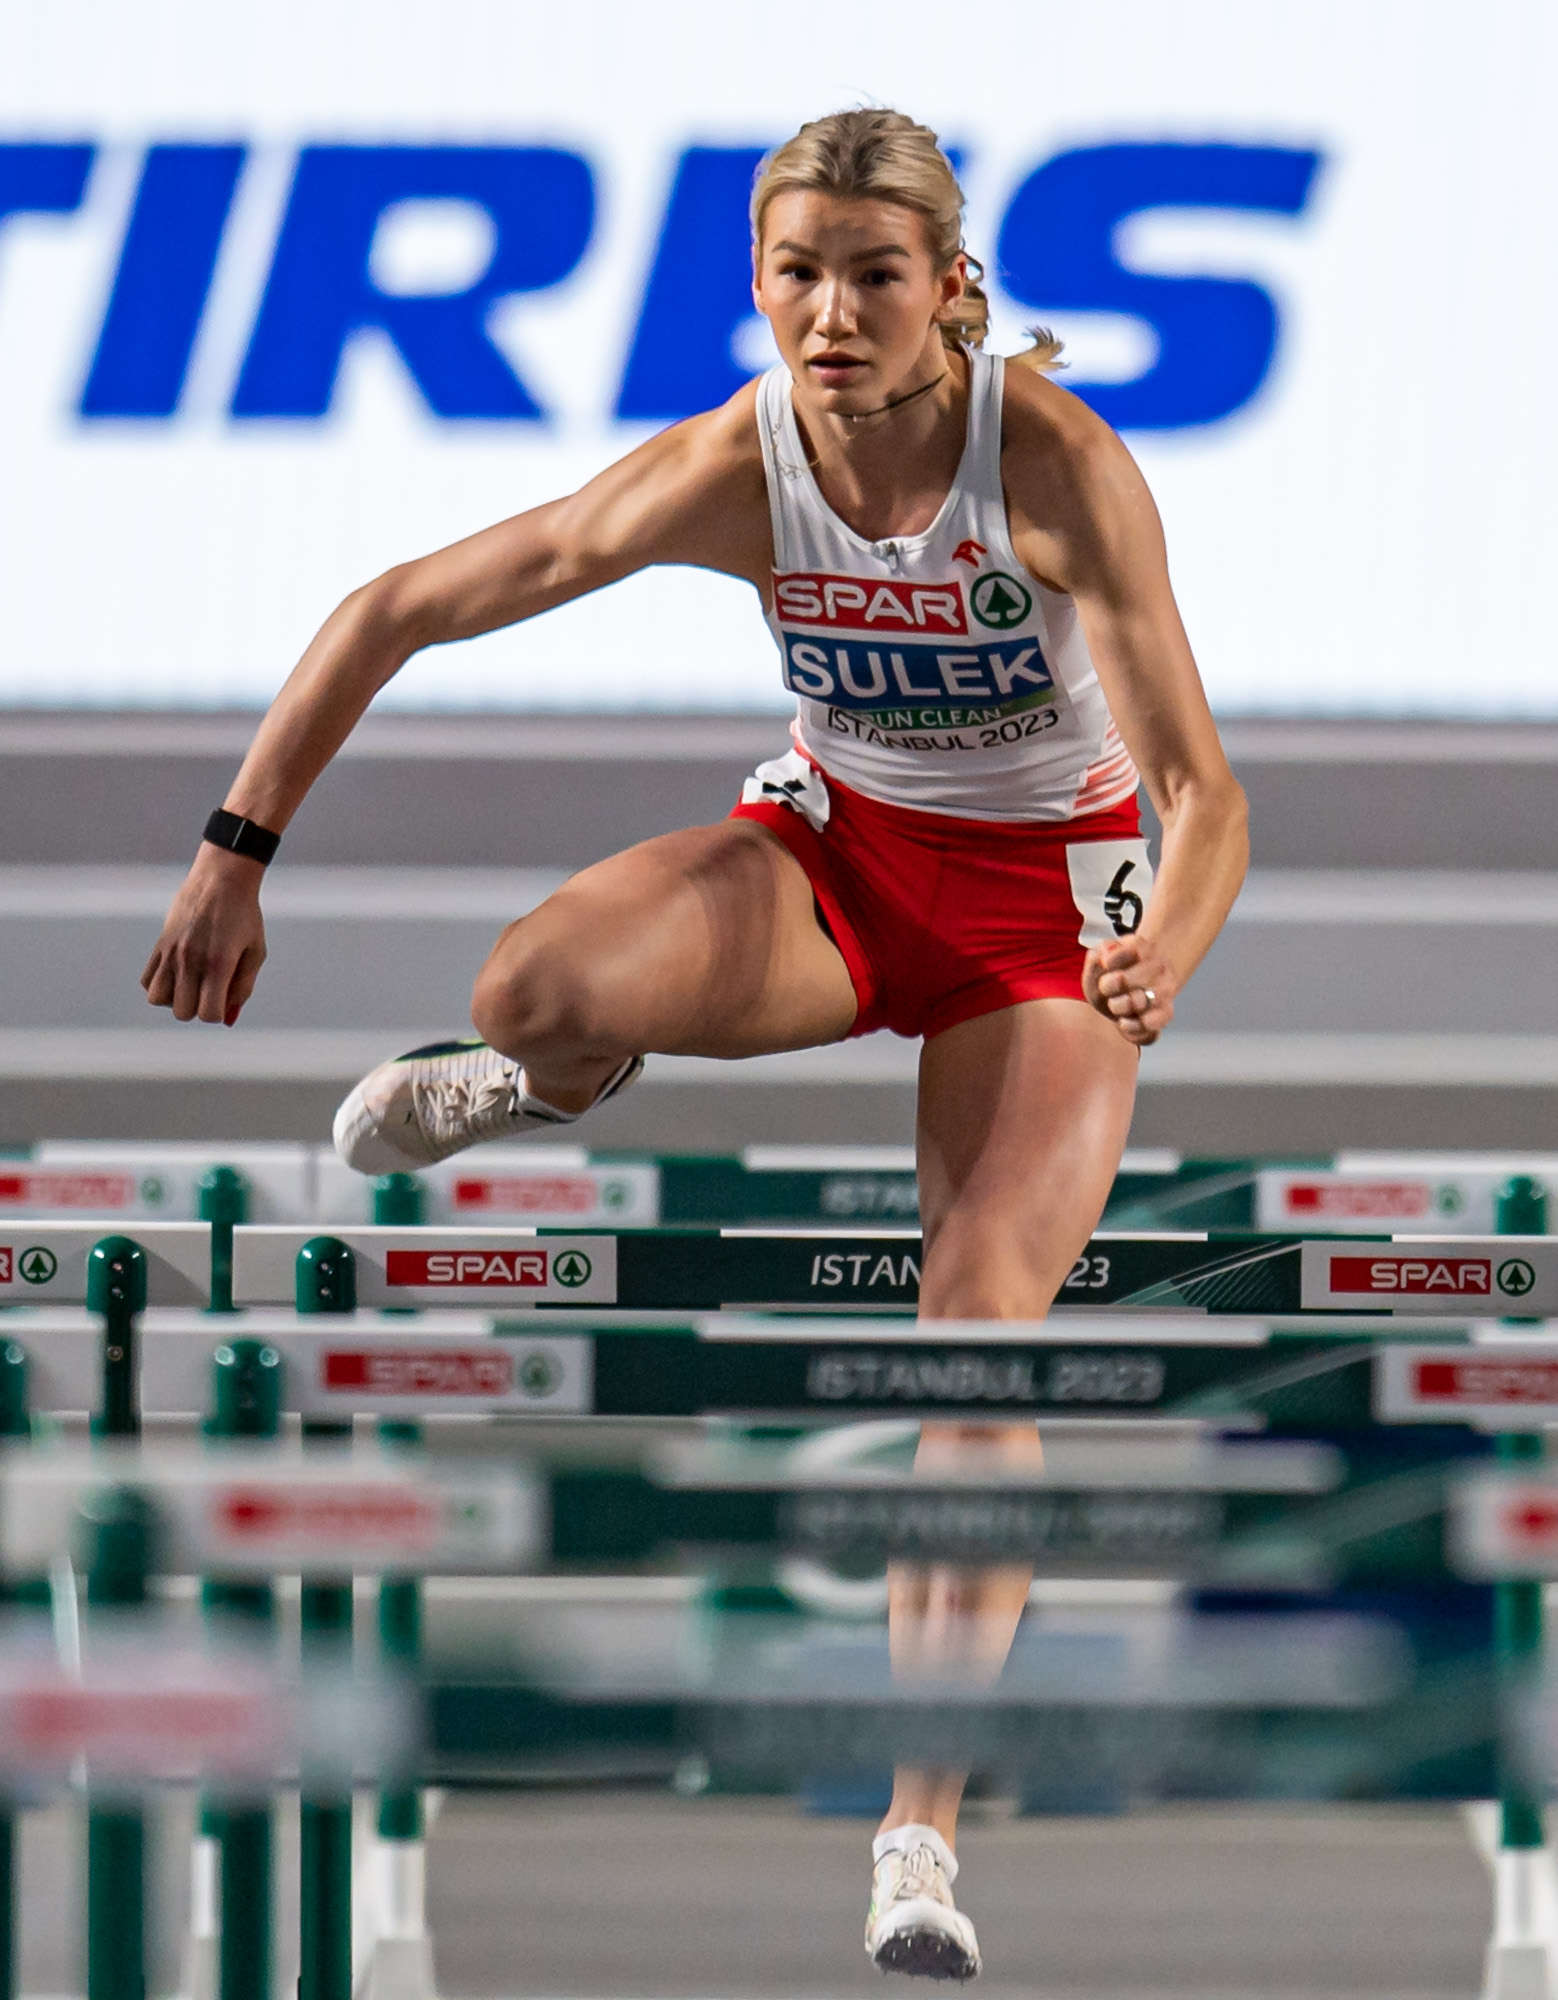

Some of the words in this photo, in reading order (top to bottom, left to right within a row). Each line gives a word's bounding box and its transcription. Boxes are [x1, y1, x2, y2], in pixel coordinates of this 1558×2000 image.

[777, 579, 961, 628] SPAR
[790, 641, 1050, 698] SULEK
[826, 705, 976, 751] ISTANBUL
[979, 708, 1060, 749] 2023
[919, 708, 1002, 728] CLEAN
[1103, 859, 1144, 937] 6
[425, 1255, 545, 1283] SPAR
[810, 1254, 922, 1287] ISTAN
[1065, 1256, 1111, 1288] 23
[1369, 1262, 1488, 1291] SPAR
